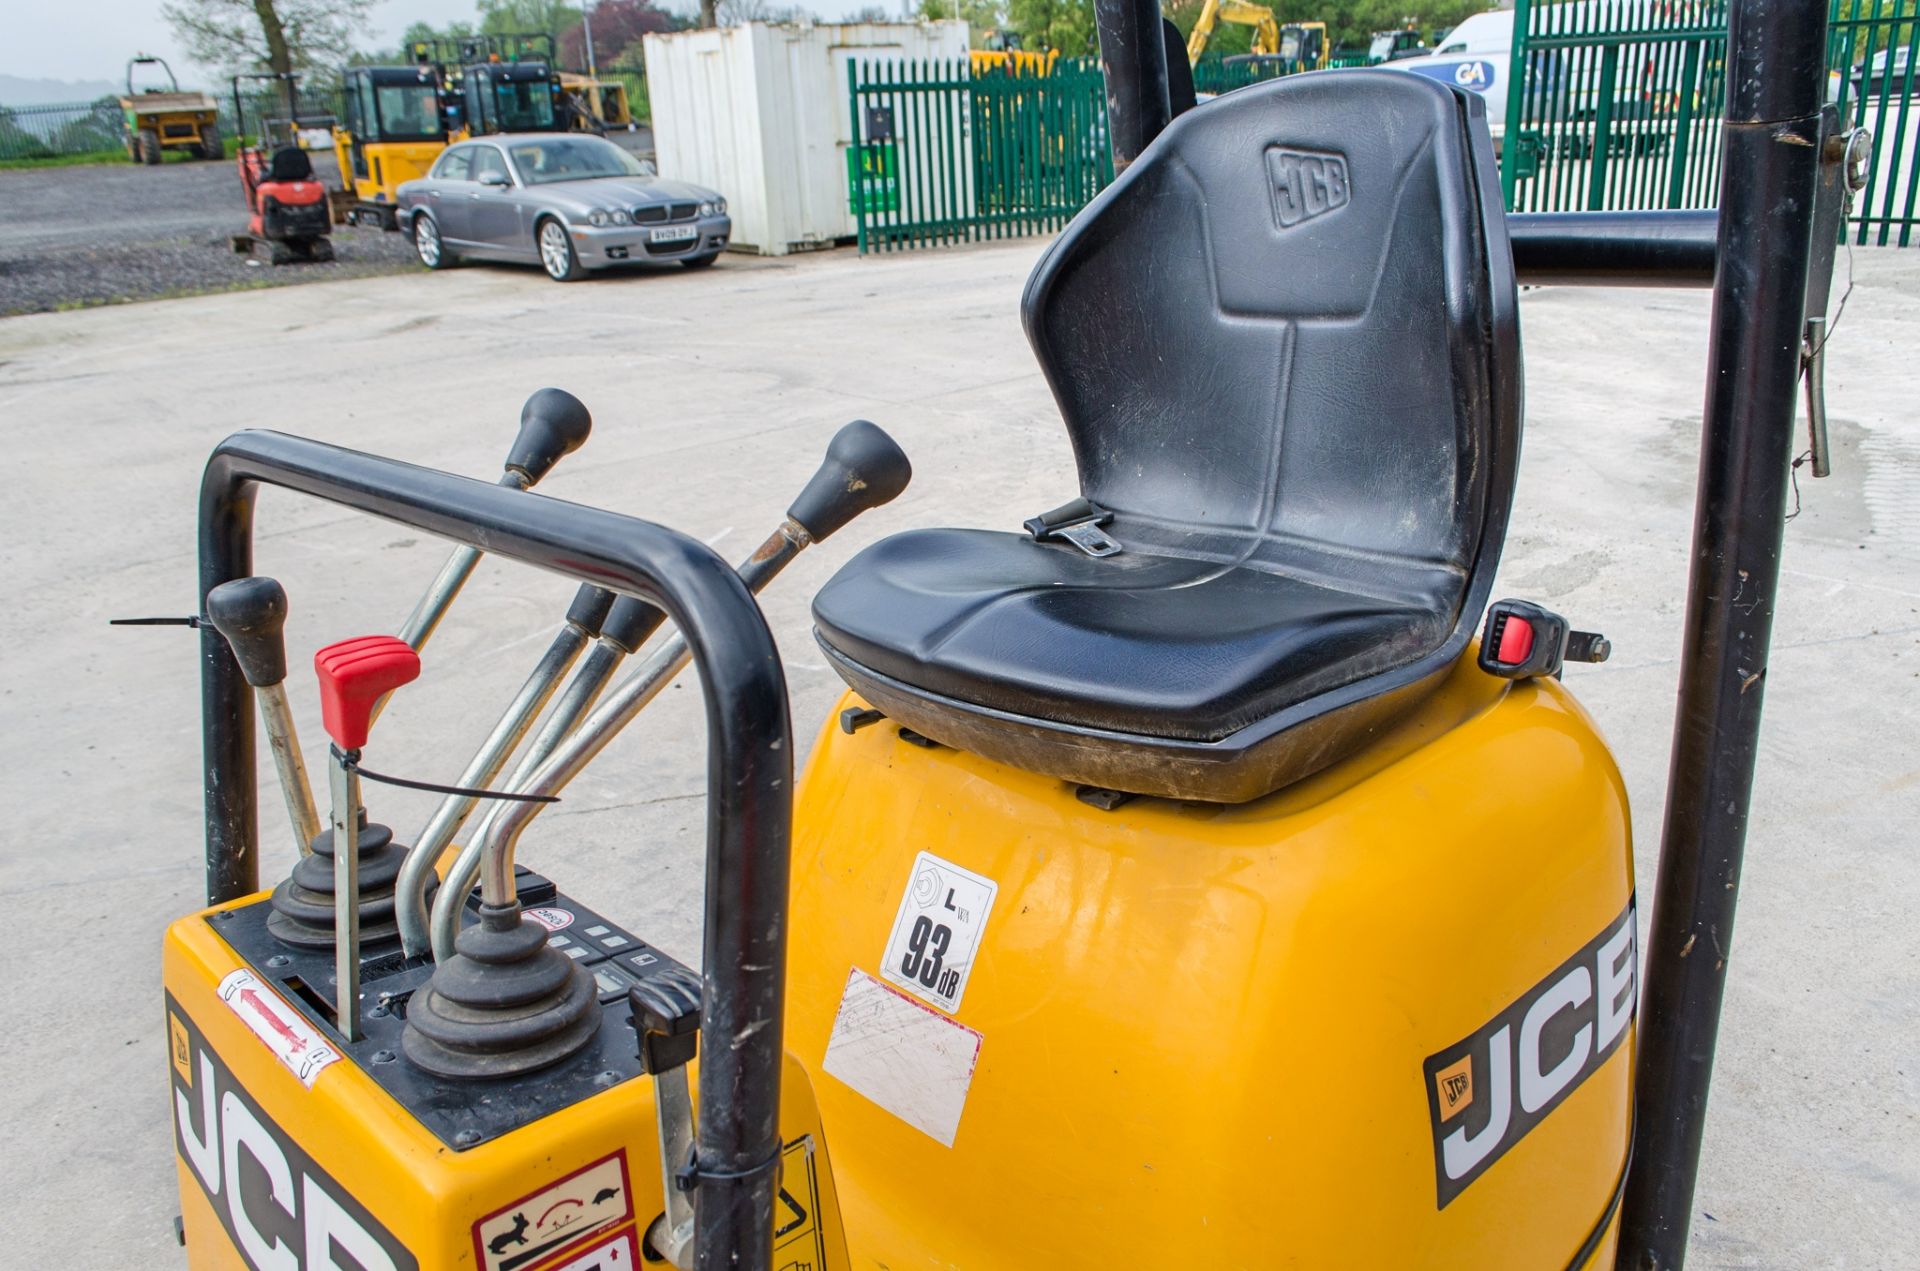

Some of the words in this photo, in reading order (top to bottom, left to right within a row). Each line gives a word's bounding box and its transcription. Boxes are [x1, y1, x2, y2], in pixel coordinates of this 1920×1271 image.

[1277, 153, 1347, 226] JCB
[944, 888, 957, 912] L
[901, 915, 952, 989] 93
[937, 968, 960, 999] dB
[1446, 1074, 1468, 1103] JCB
